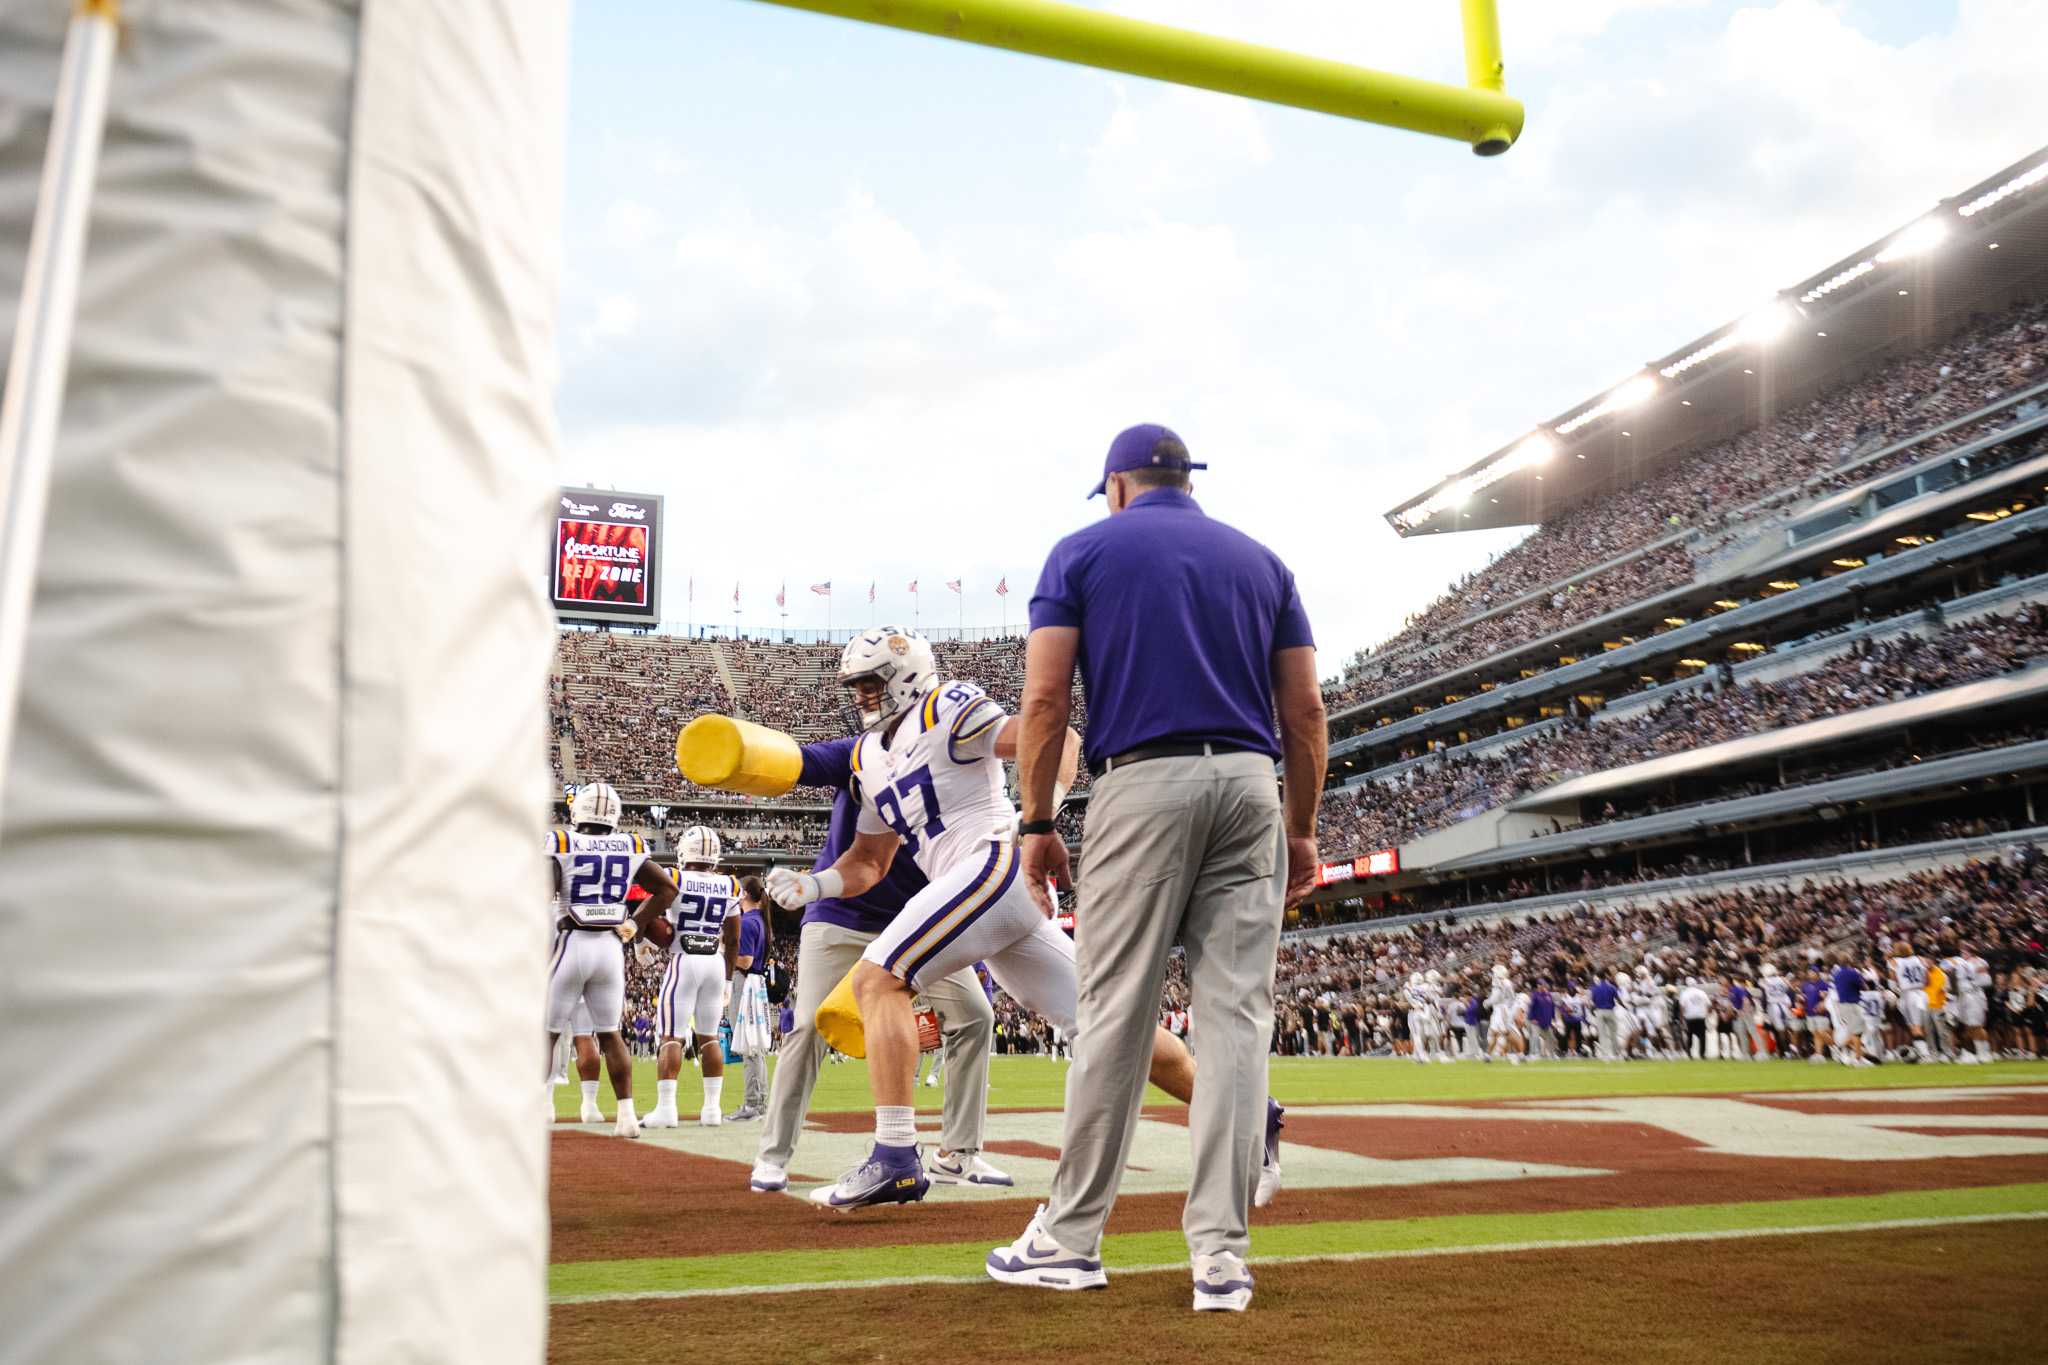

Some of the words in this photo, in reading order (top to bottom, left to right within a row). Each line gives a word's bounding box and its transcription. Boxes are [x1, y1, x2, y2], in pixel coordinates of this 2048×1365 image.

[565, 537, 641, 559] OPPORTUNE
[562, 563, 594, 579] RED
[599, 566, 643, 583] ZONE
[573, 839, 584, 852] K.
[586, 840, 629, 852] JACKSON
[571, 855, 630, 904] 28
[686, 880, 728, 895] DURHAM
[585, 907, 617, 917] DOUGLAS
[677, 893, 728, 934] 29
[895, 1177, 916, 1189] LSU
